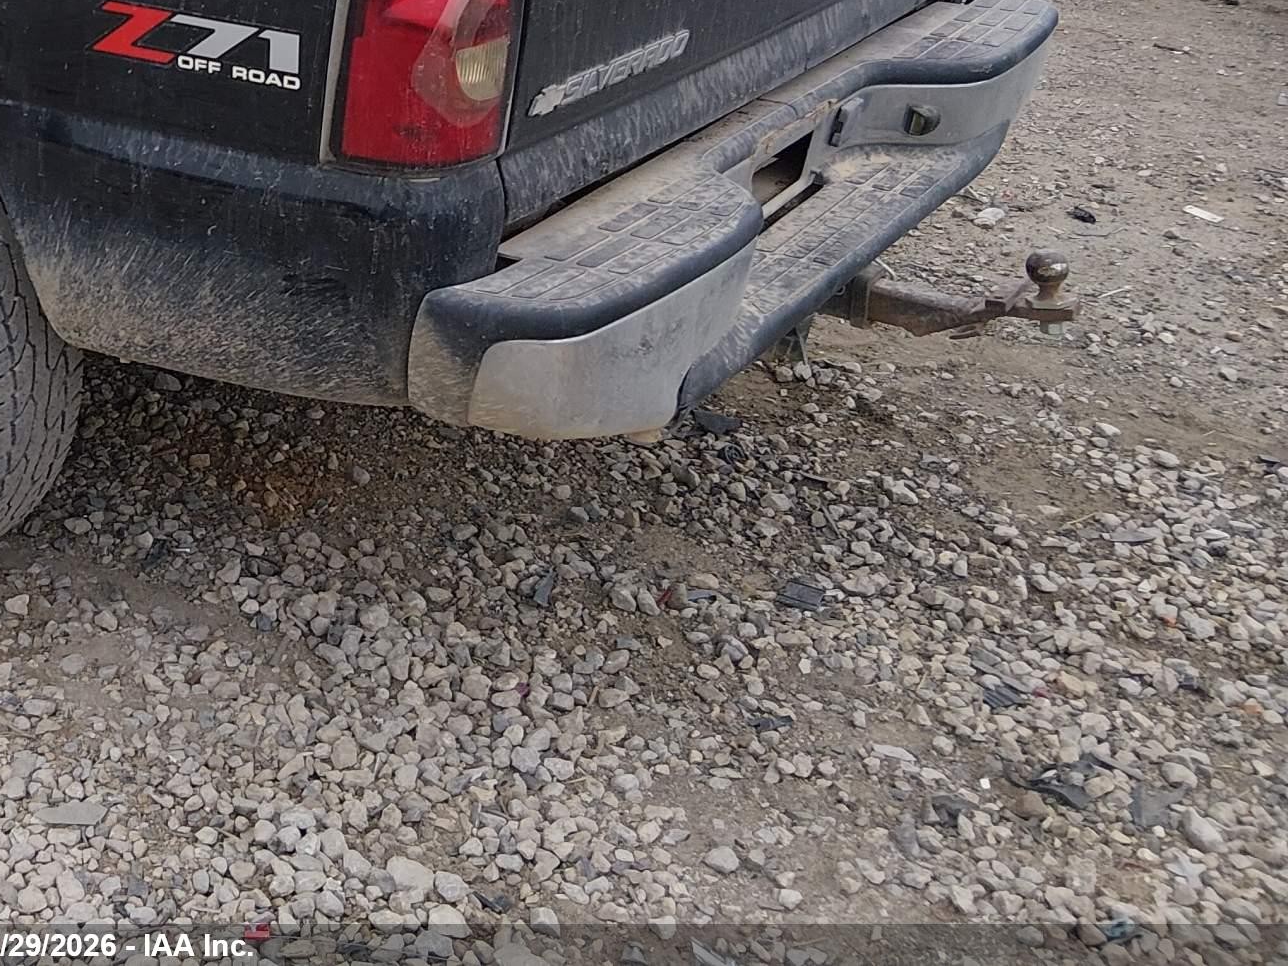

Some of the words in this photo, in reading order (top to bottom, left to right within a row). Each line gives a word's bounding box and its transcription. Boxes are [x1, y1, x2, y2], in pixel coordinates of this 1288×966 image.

[92, 0, 301, 74] Z71
[177, 55, 221, 74] OFF
[231, 66, 301, 91] ROAD
[560, 29, 690, 106] SILVERADO
